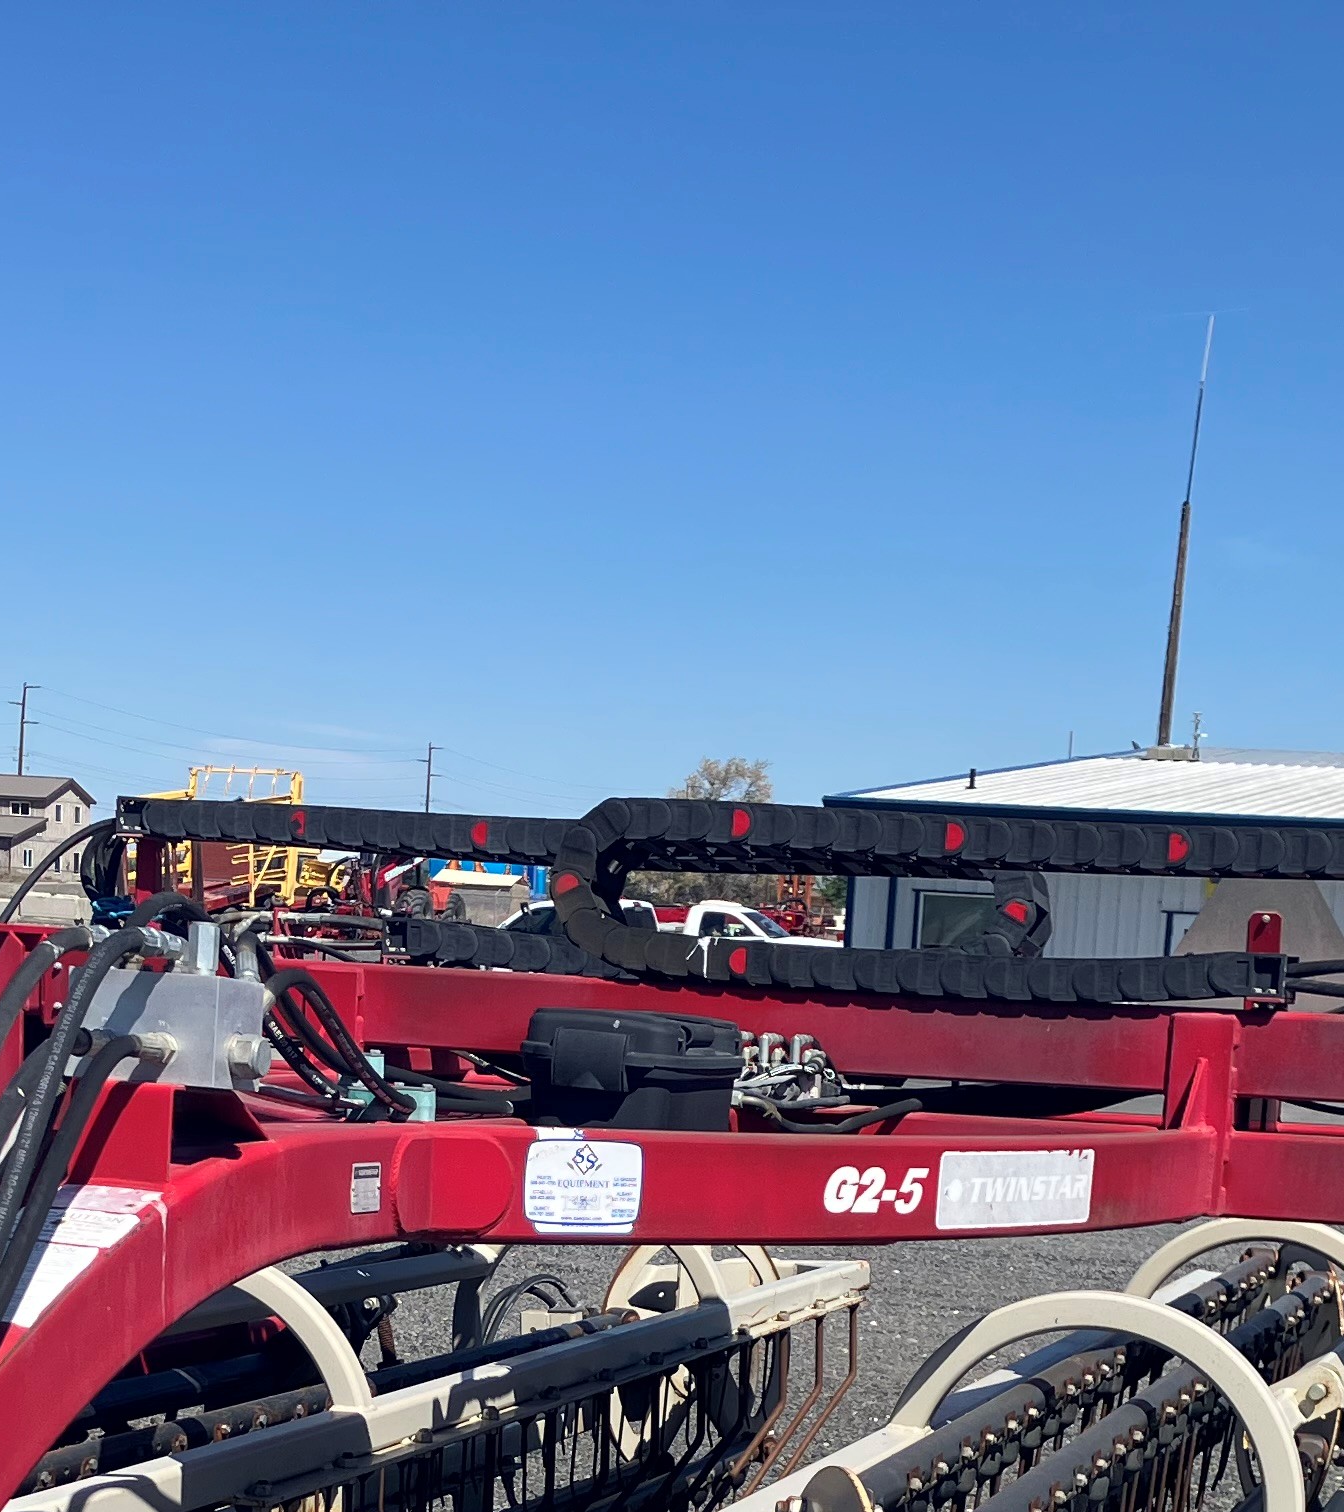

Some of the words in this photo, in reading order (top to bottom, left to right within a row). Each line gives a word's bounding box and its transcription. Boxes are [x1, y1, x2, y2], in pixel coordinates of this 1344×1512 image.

[557, 1179, 610, 1189] EQUIPMENT
[823, 1166, 930, 1214] G2-5
[970, 1174, 1088, 1203] TWINSTAR
